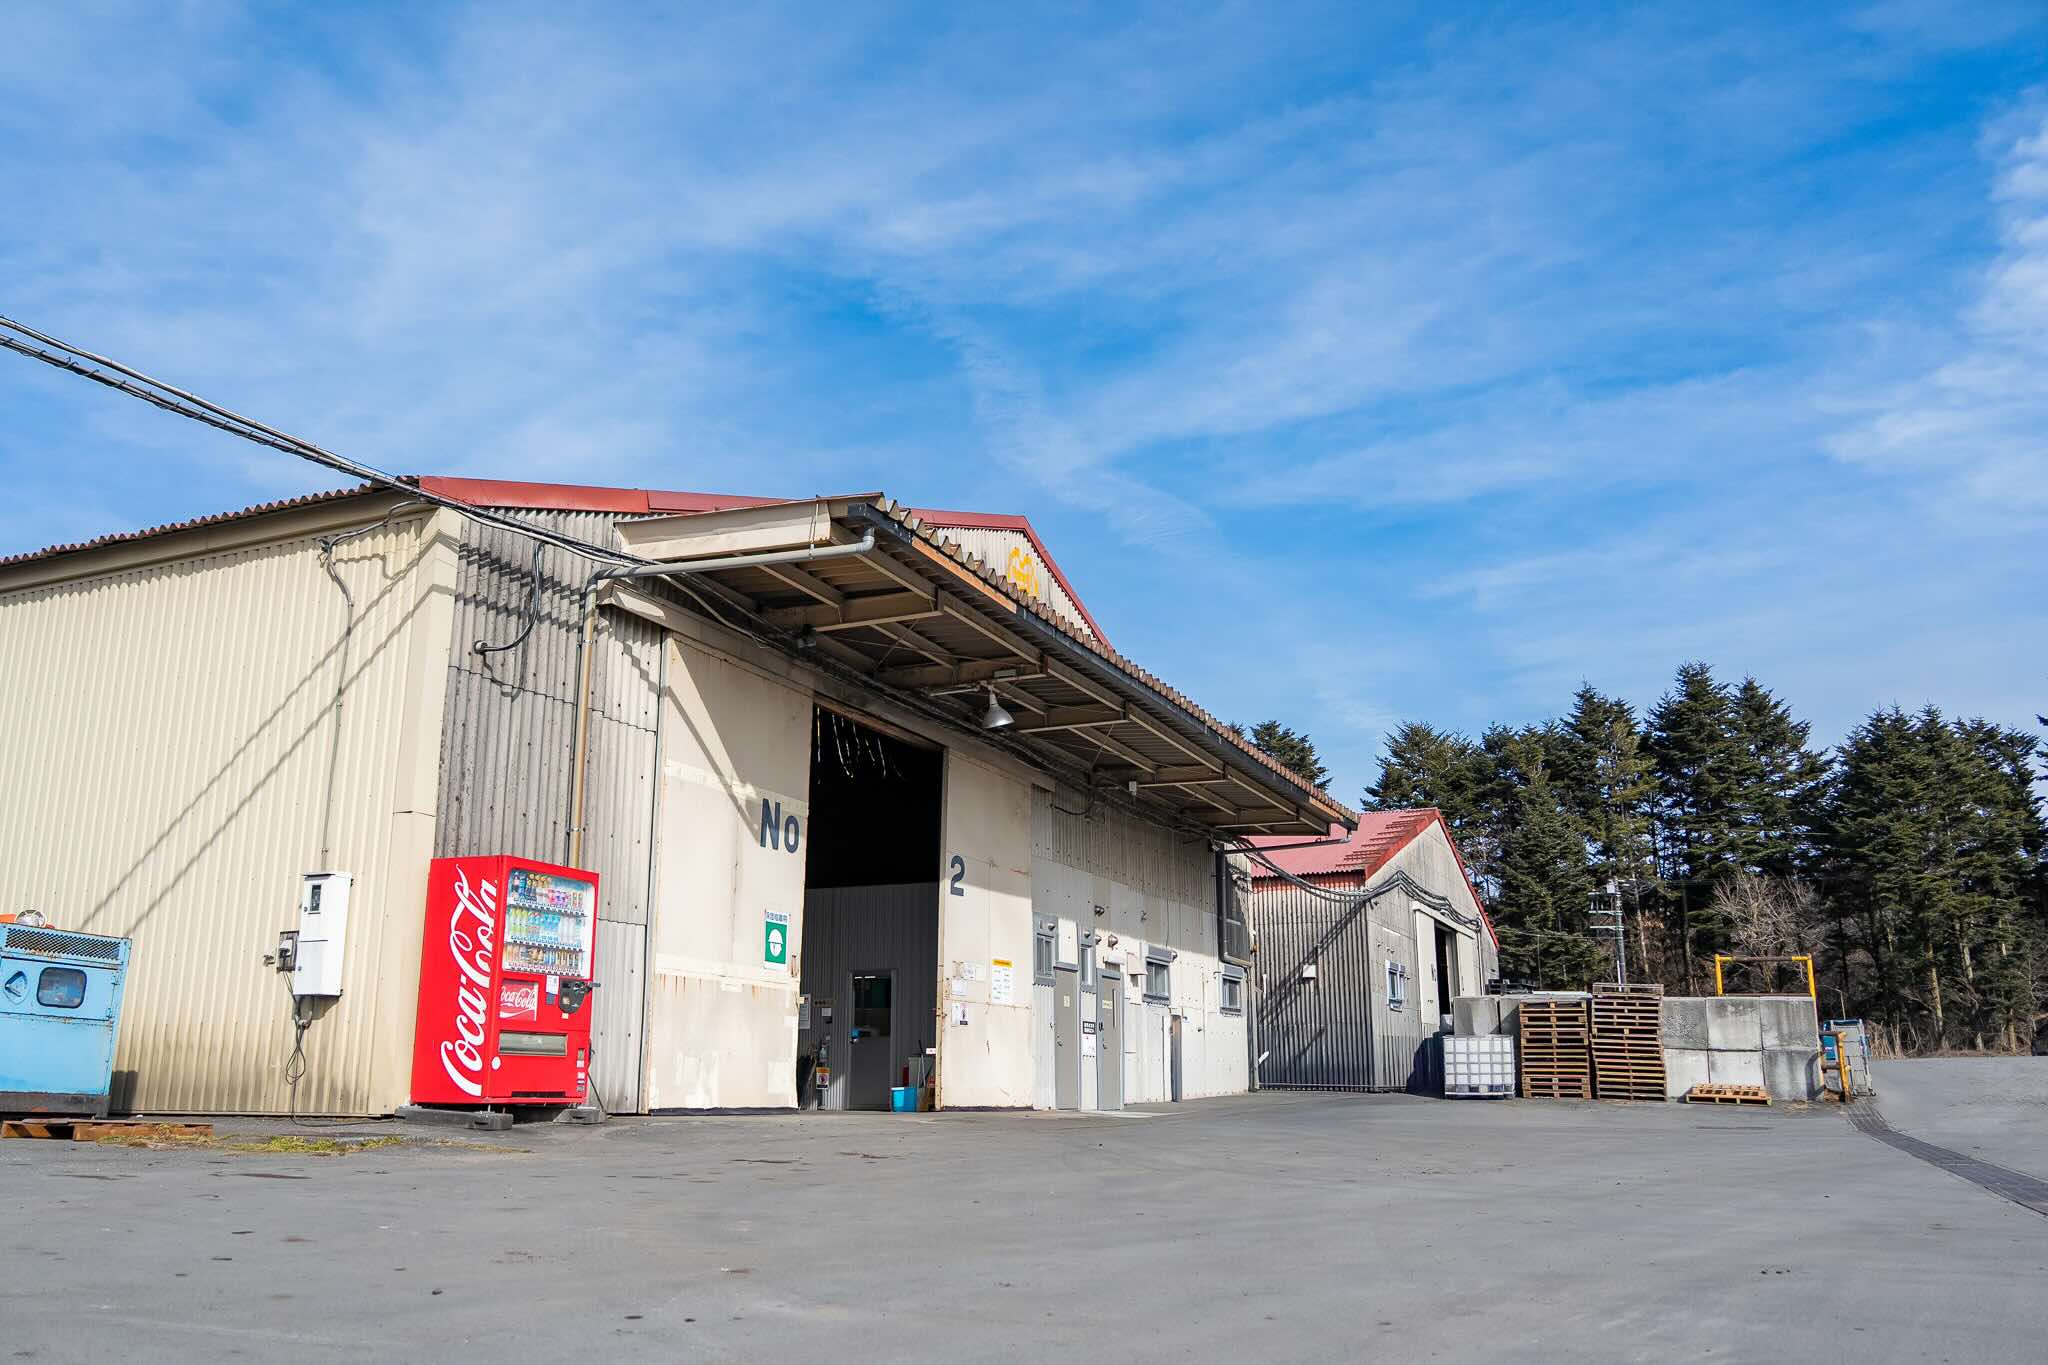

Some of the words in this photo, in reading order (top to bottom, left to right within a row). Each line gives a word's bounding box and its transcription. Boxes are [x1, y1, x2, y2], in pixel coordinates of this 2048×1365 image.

[760, 798, 800, 853] No
[950, 855, 965, 896] 2
[441, 863, 498, 1097] Coca-Cola
